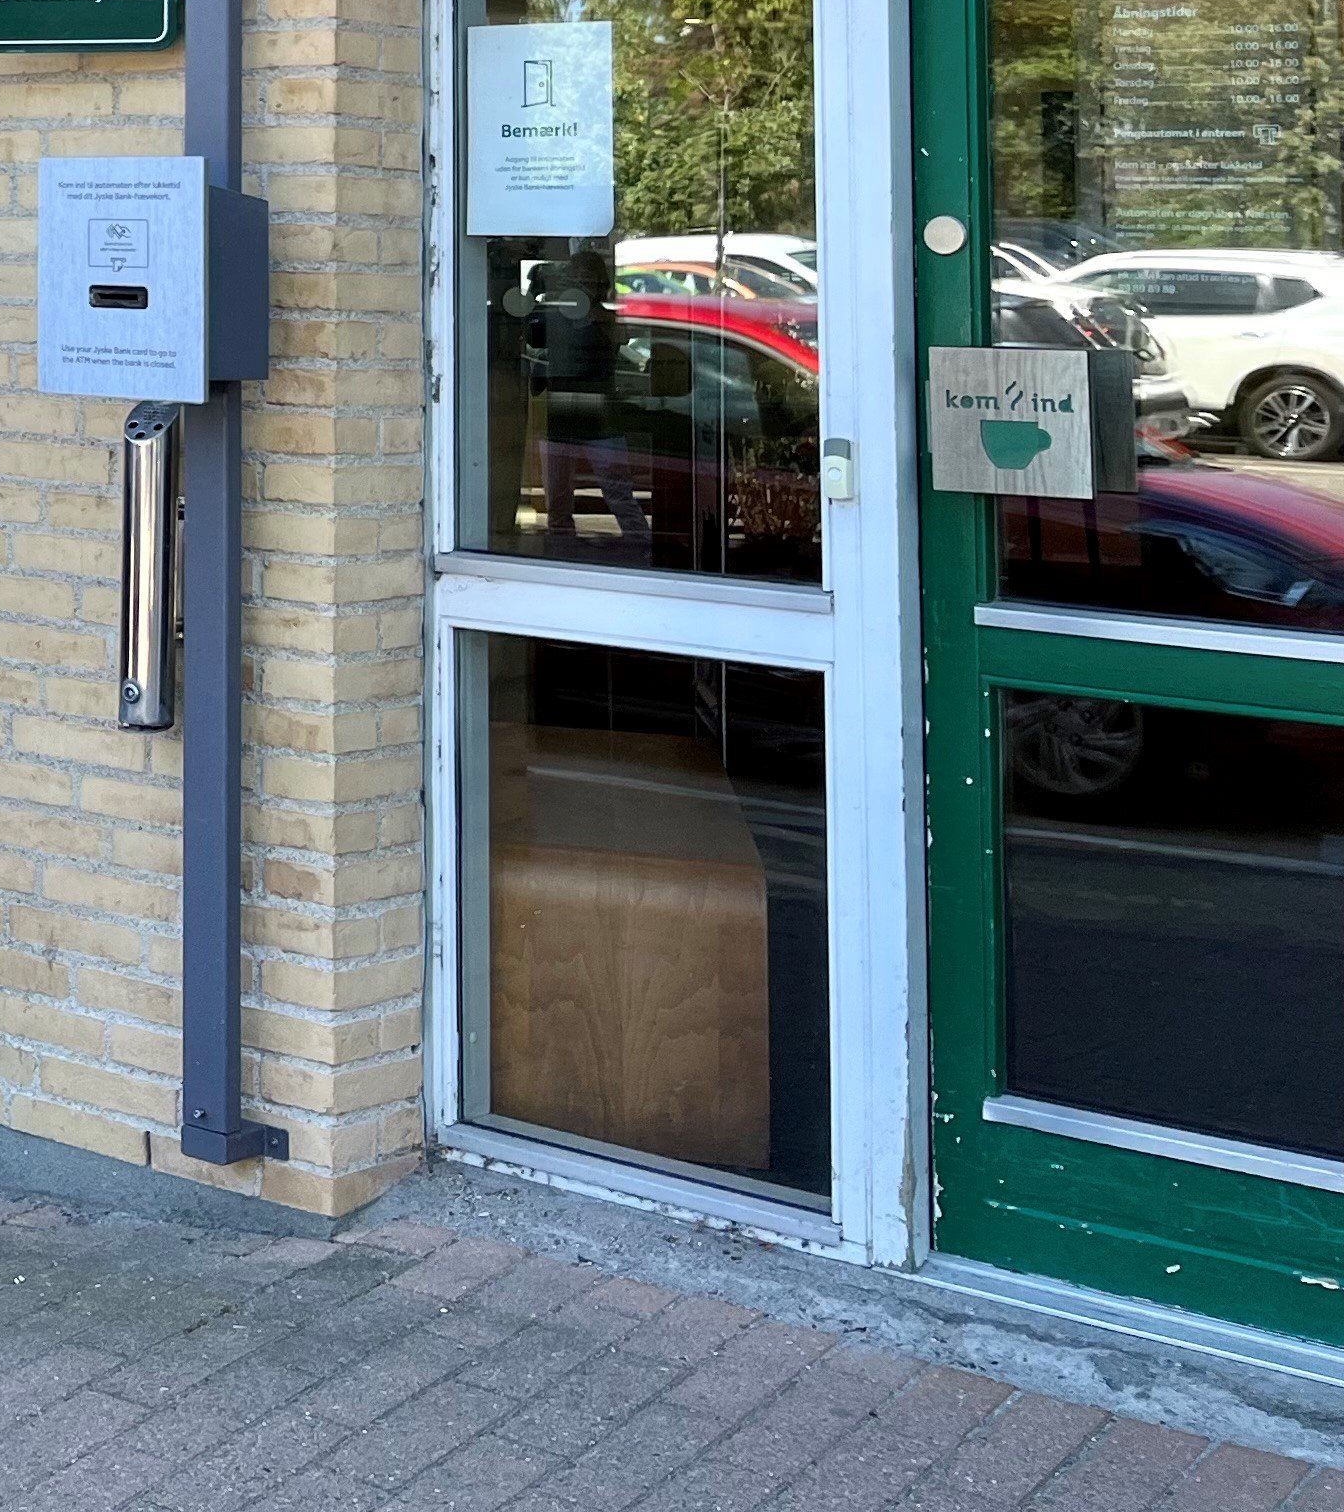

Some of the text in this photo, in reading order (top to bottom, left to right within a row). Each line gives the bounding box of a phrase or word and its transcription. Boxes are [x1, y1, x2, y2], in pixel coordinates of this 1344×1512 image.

[501, 121, 578, 138] Bemærk!
[945, 389, 1074, 414] kom ind
